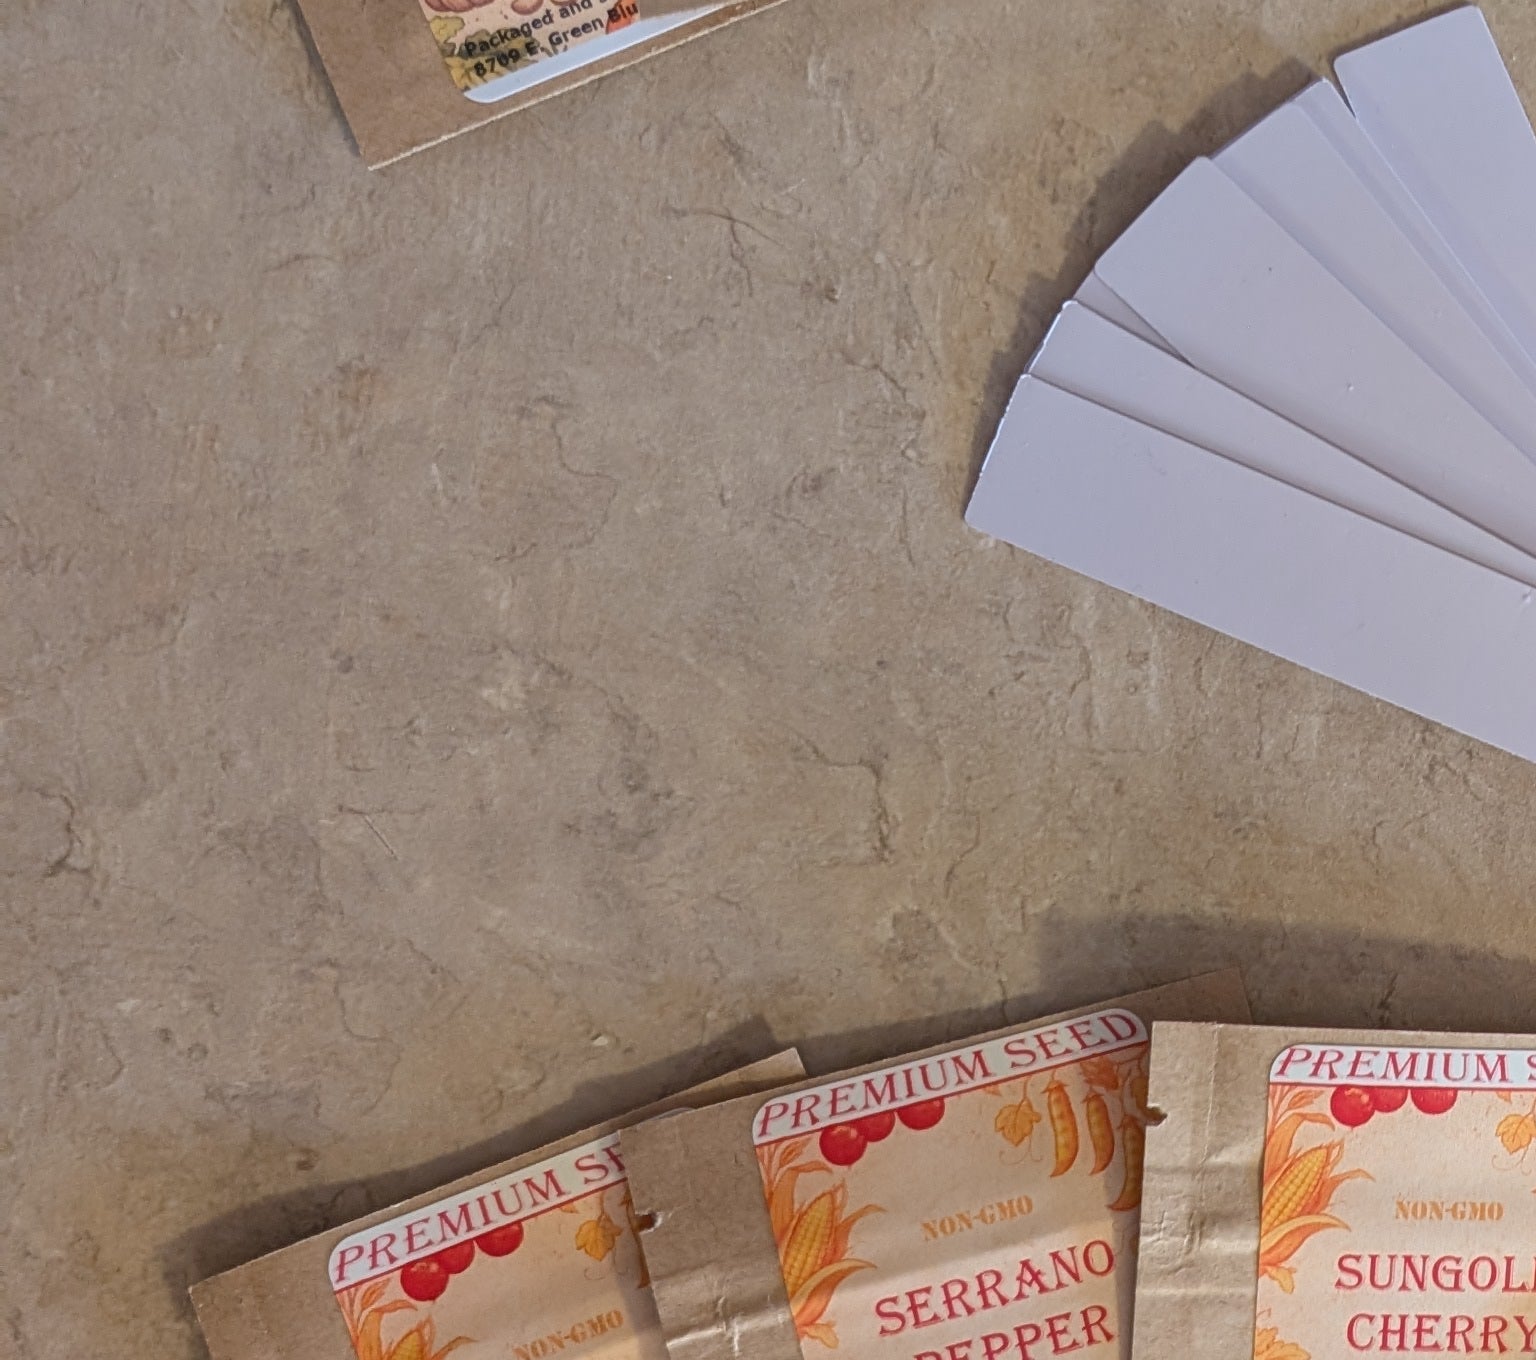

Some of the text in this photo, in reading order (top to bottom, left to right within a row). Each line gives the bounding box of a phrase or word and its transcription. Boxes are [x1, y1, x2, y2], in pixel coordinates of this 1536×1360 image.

[757, 1013, 1138, 1138] PREMIUM SEED
[328, 1169, 567, 1284] PREMIUM
[921, 1195, 1034, 1242] NON-GMO
[1394, 1198, 1504, 1222] NON-GMO
[874, 1239, 1114, 1337] SERRANO
